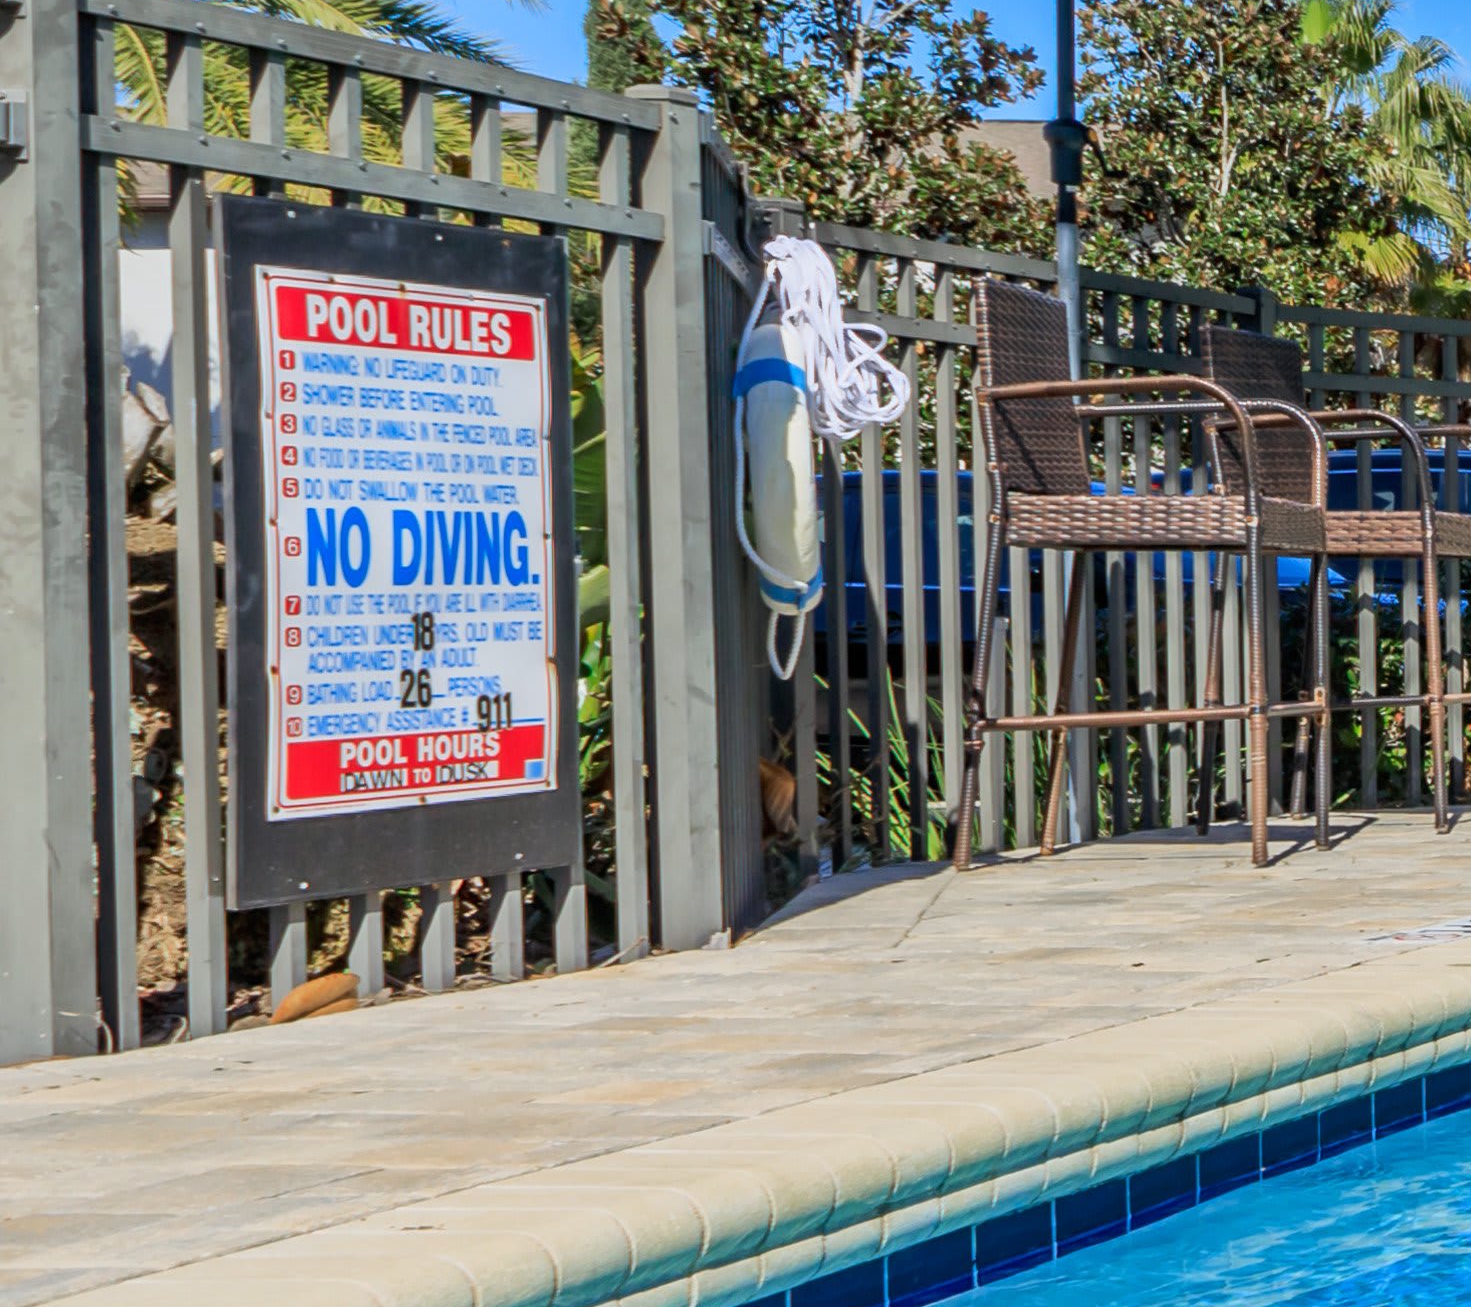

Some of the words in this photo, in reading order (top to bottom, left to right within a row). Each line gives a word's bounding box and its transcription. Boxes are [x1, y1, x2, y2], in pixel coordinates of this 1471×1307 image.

[305, 293, 398, 344] POOL
[408, 304, 512, 356] RULES
[364, 356, 380, 378] NO
[386, 358, 446, 383] LIFEGUARD
[451, 362, 467, 384] ON
[303, 383, 355, 407] SHOWER
[360, 387, 406, 410] BEFORE
[410, 391, 465, 414] ENTERING
[303, 415, 316, 436] NO
[322, 416, 354, 438] GLASS
[359, 418, 372, 439] OR
[376, 419, 416, 441] ANIMALS
[420, 422, 429, 441] IN
[432, 422, 449, 442] THE
[452, 423, 485, 444] FENCED
[488, 425, 512, 446] POOL
[303, 446, 316, 467] NO
[319, 447, 343, 469] FOOD
[348, 448, 359, 469] OR
[362, 449, 413, 471] BEVERAGES
[426, 452, 448, 473] POOL
[304, 478, 323, 499] DO
[328, 479, 354, 500] NOT
[359, 480, 418, 502] SWALLOW
[423, 482, 446, 503] THE
[449, 483, 480, 504] POOL
[306, 506, 371, 588] NO
[392, 509, 540, 586] DIVING.
[306, 594, 319, 614] DO
[324, 594, 343, 614] NOT
[346, 594, 364, 613] USE
[367, 593, 385, 613] THE
[388, 593, 412, 613] POOL
[306, 625, 368, 646] CHILDREN
[374, 624, 415, 644] UNDER
[411, 611, 434, 651] 18
[465, 622, 488, 642] OLD
[493, 621, 524, 641] MUST
[528, 621, 543, 640] BE
[307, 650, 395, 673] ACCOMPANIED
[400, 649, 416, 670] BY
[421, 648, 437, 669] AN
[306, 682, 357, 704] BATHING
[362, 680, 393, 701] LOAD
[400, 667, 432, 709] 26
[307, 712, 380, 735] EMERGENCY
[386, 708, 457, 731] ASSISTANCE
[477, 691, 512, 733] 911
[340, 738, 408, 769] POOL
[418, 732, 500, 762] HOURS
[345, 769, 403, 791] DAWN
[413, 767, 432, 784] TO
[439, 761, 488, 784] DUSK
